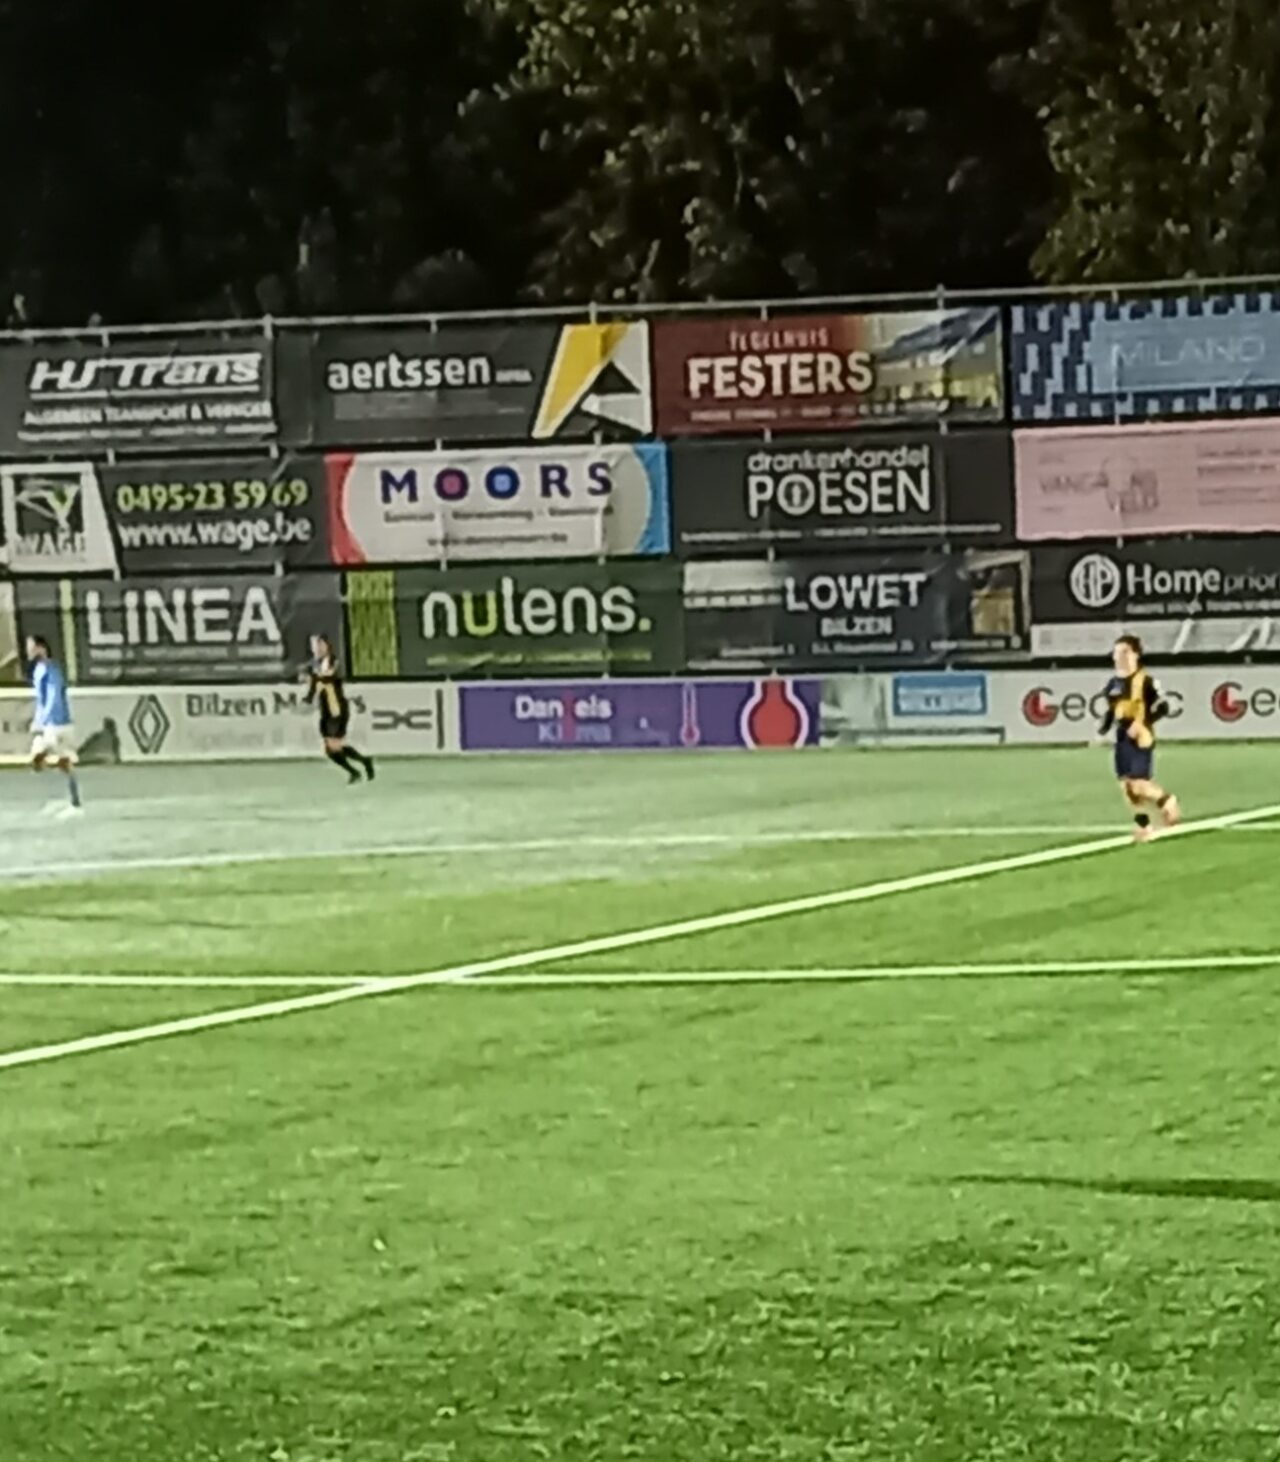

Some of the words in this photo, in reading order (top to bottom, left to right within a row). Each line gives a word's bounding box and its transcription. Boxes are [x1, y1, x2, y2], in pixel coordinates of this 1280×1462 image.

[1111, 336, 1266, 366] MILANO
[328, 353, 490, 390] aertssen
[687, 351, 874, 400] FESTERS
[748, 444, 931, 472] drankenhandel
[117, 482, 226, 512] 0495-23
[234, 481, 267, 510] 59
[272, 478, 308, 508] 69
[380, 462, 613, 504] MOORS
[747, 469, 931, 519] POESEN
[118, 512, 312, 551] www.wage.be
[422, 576, 653, 638] nulens.
[784, 572, 928, 611] LOWET
[86, 586, 282, 645] LINEA
[821, 615, 893, 637] BILZEN
[186, 693, 267, 717] Bilzen
